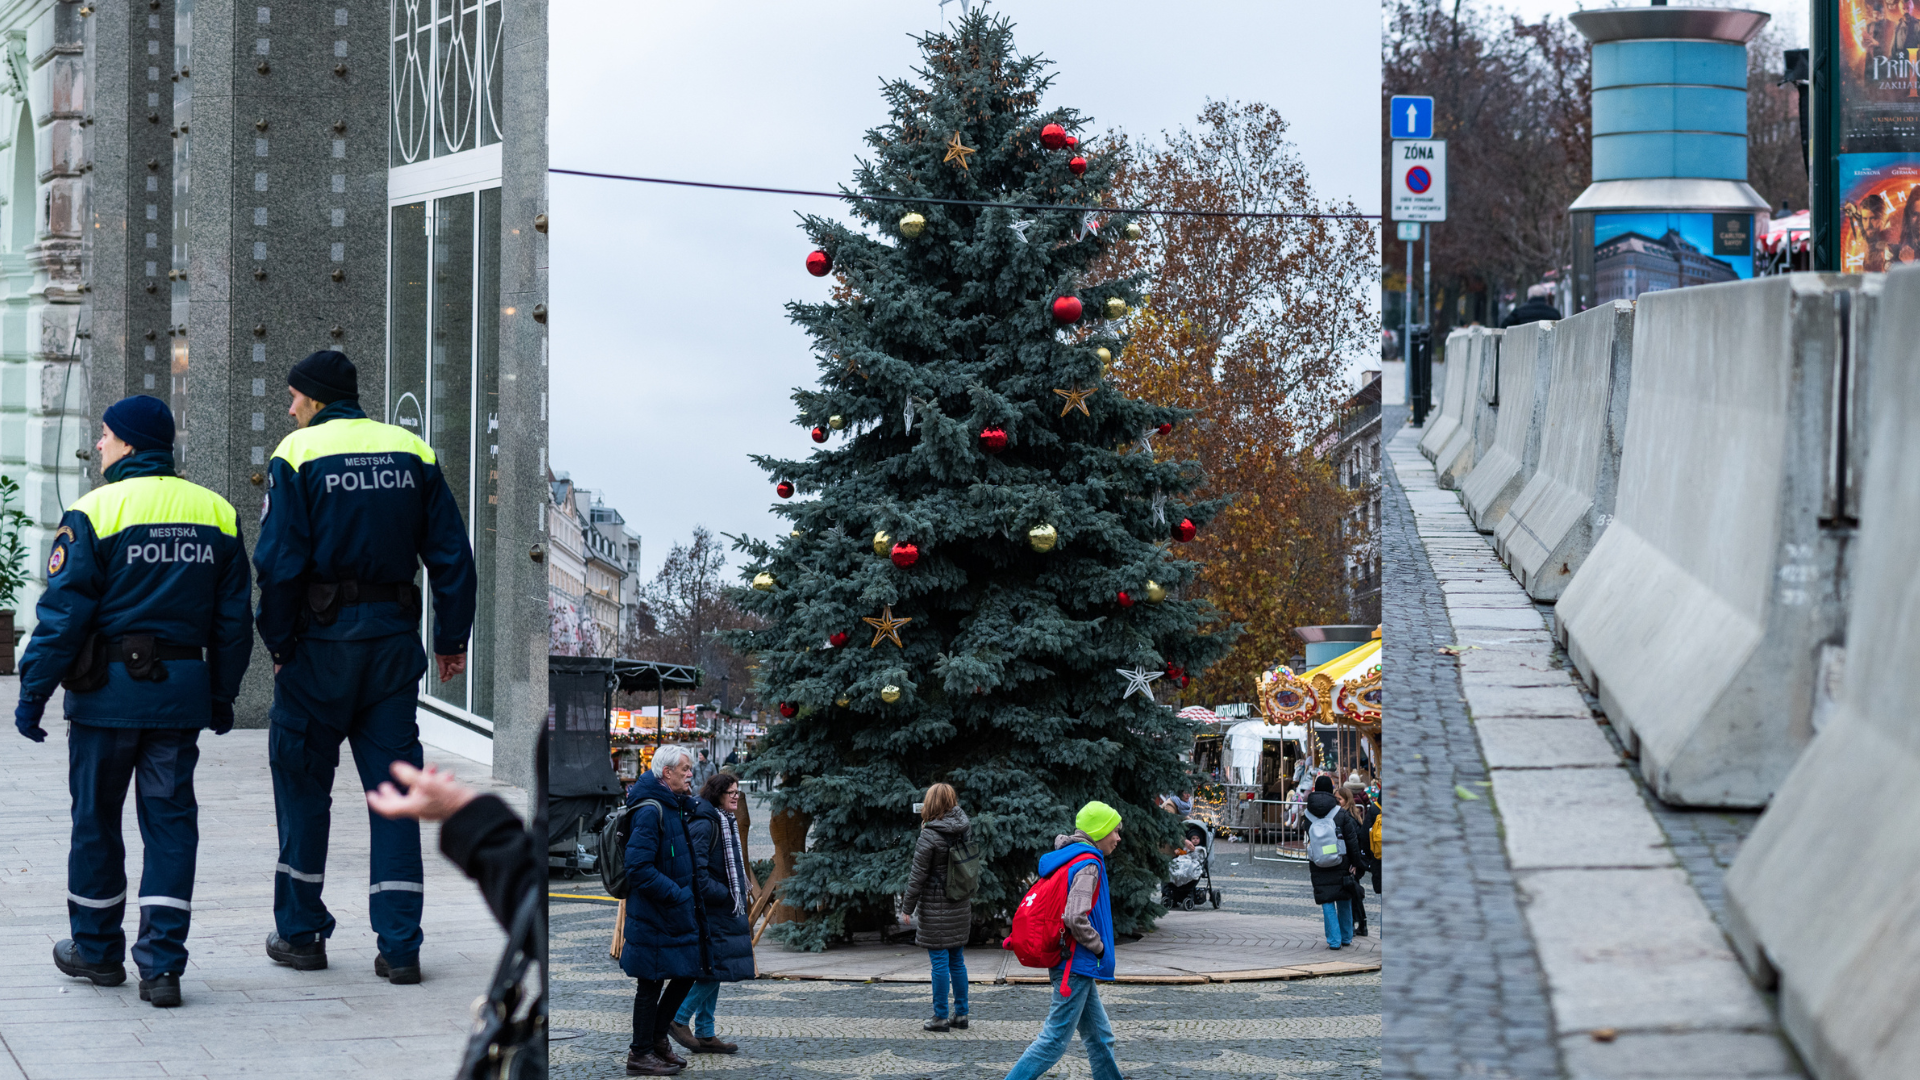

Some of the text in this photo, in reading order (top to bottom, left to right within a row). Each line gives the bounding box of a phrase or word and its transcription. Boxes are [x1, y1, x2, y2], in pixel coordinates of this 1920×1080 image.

[1404, 143, 1435, 160] ZÓNA
[344, 453, 395, 467] MESTSKÁ
[325, 466, 416, 494] POLÍCIA
[149, 526, 198, 538] MESTSKÁ
[127, 537, 215, 565] POLÍCIA
